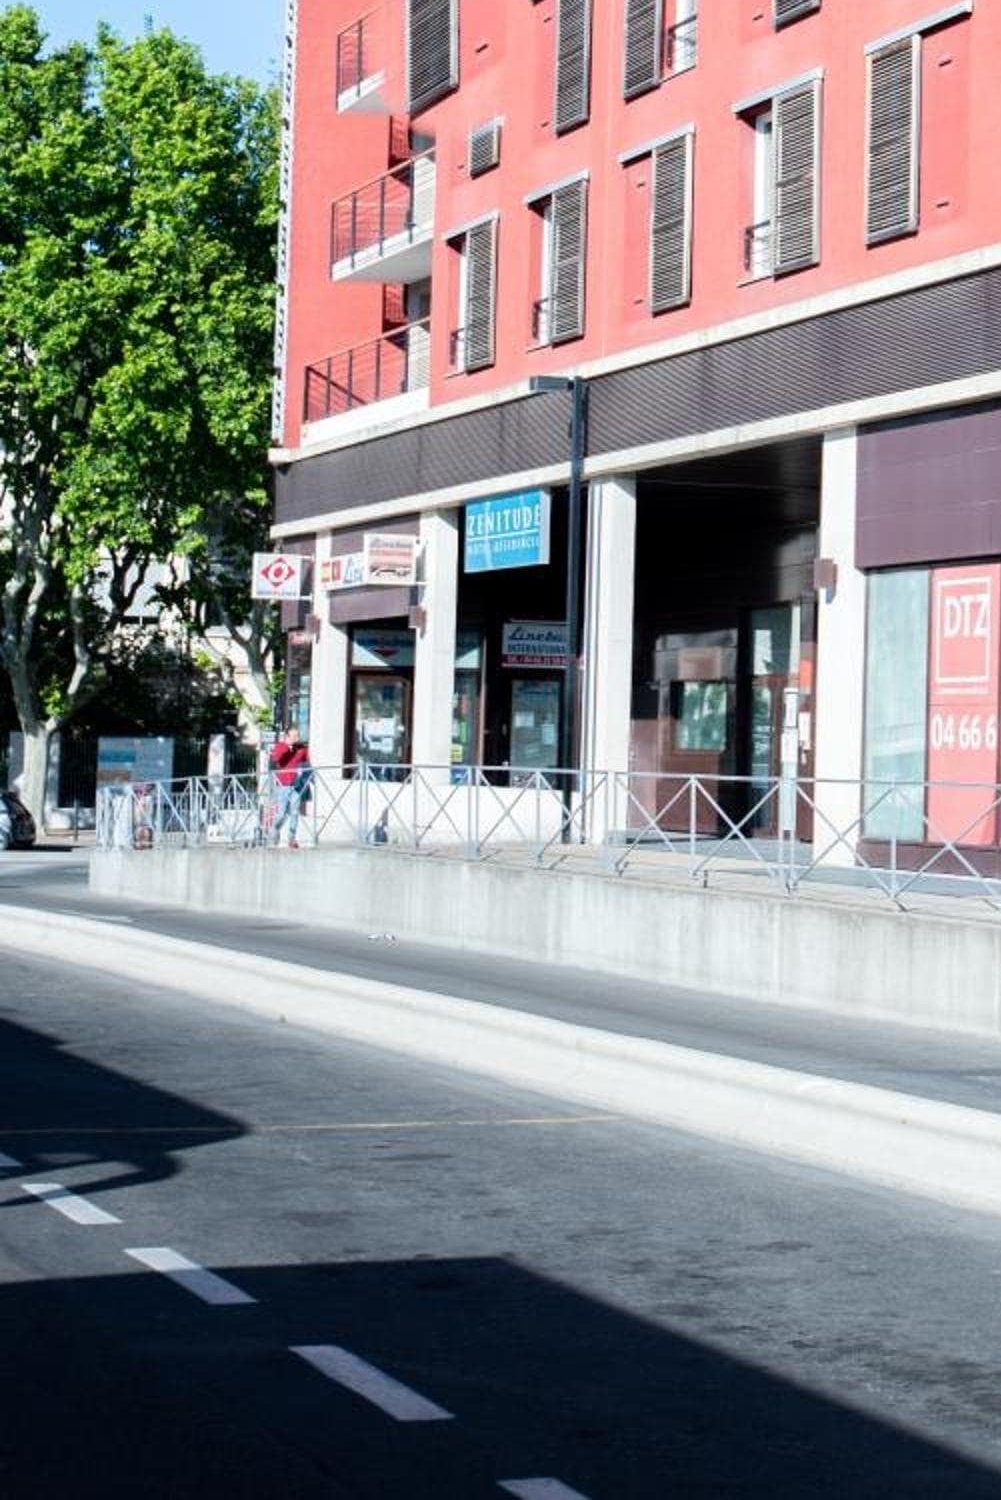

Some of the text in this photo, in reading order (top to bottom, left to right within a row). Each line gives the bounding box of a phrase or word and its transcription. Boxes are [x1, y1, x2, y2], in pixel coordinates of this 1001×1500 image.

[466, 503, 540, 537] ZENITUDE
[943, 593, 991, 639] DTZ
[931, 713, 955, 749] 04
[959, 714, 982, 750] 66
